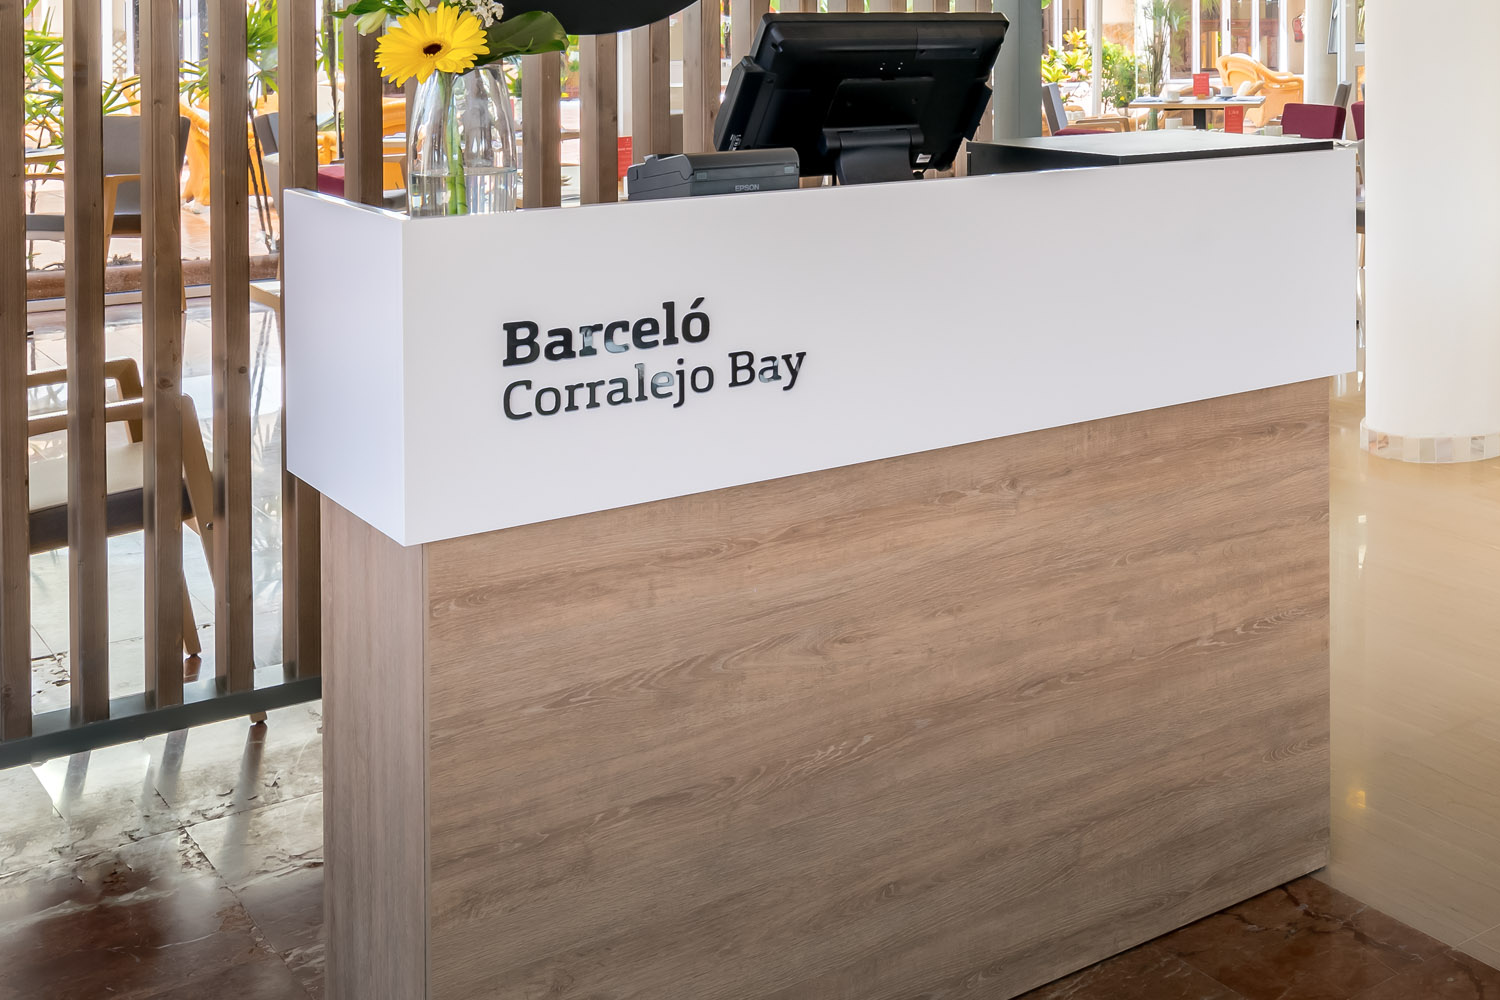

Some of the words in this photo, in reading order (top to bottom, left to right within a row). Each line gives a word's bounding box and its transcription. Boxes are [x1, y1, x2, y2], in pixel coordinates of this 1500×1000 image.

[502, 297, 710, 367] Barceló
[502, 358, 715, 420] Corralejo
[728, 350, 806, 391] Bay
